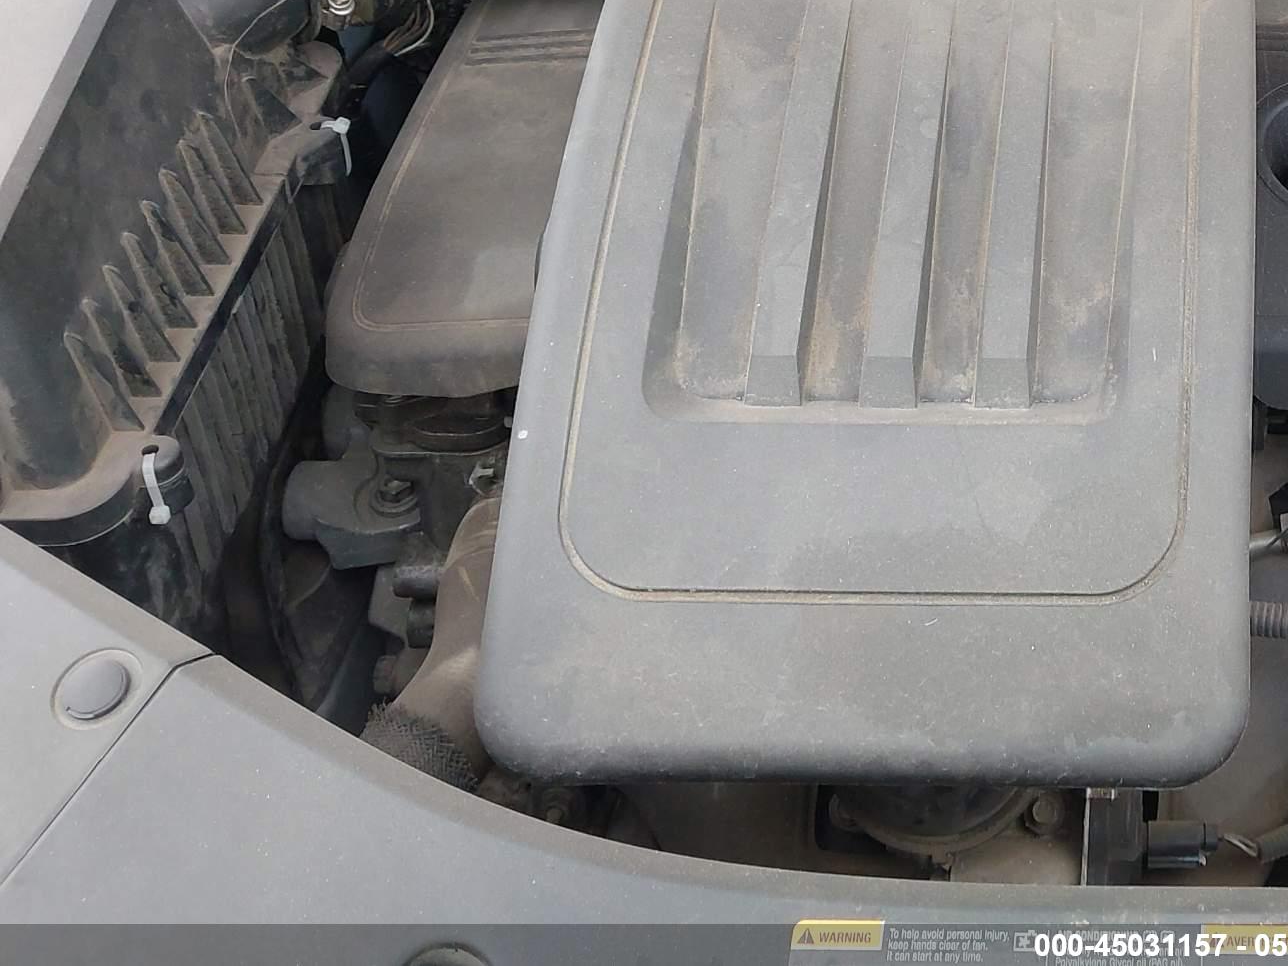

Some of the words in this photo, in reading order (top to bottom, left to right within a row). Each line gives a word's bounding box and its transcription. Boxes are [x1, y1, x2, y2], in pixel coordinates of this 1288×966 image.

[818, 931, 872, 943] WARNING
[889, 927, 900, 939] To
[901, 927, 919, 941] help
[921, 928, 945, 939] avoid
[946, 929, 983, 941] personal
[887, 939, 909, 951] keep
[910, 939, 937, 951] hands
[938, 940, 960, 951] clear
[961, 940, 971, 951] of
[972, 940, 988, 951] fan.
[894, 952, 910, 962] can
[911, 951, 932, 962] start
[933, 951, 943, 962] at
[944, 952, 960, 964] any
[961, 951, 984, 962] time.
